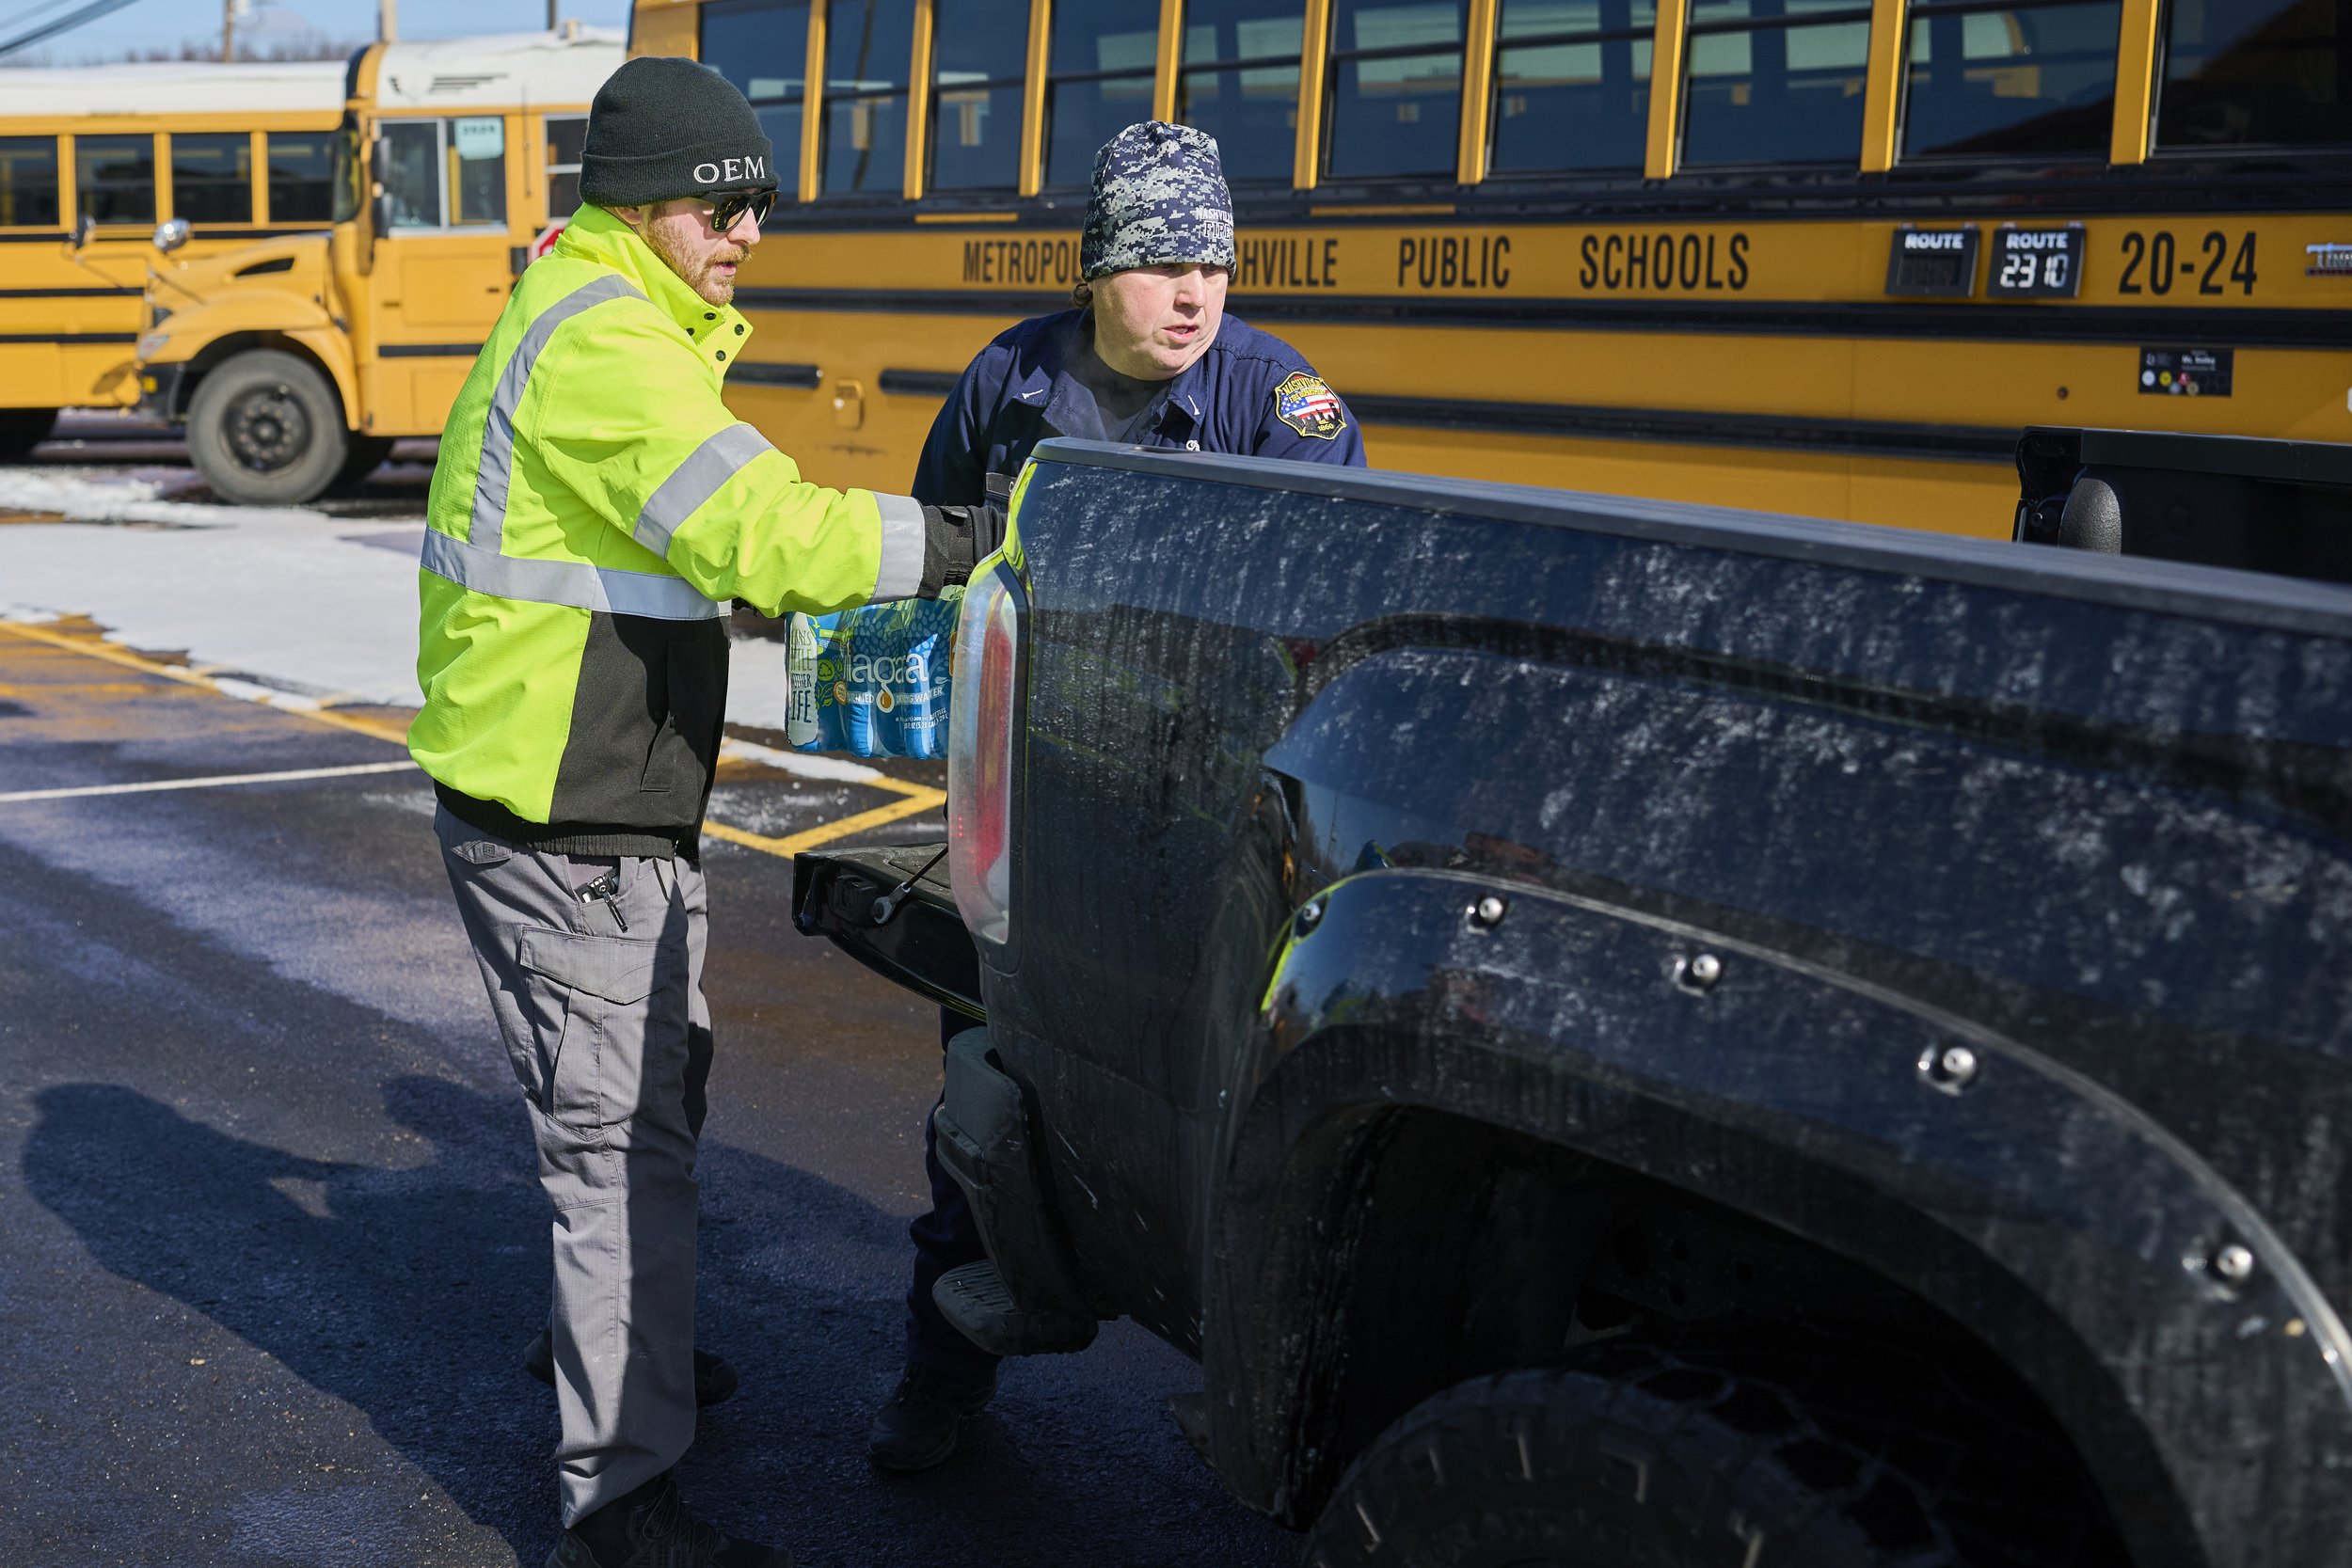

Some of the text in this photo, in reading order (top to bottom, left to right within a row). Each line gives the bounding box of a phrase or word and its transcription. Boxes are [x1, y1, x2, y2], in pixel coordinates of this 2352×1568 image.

[693, 155, 766, 183] OEM
[1904, 232, 1964, 250] ROUTE
[2006, 231, 2068, 250] ROUTE
[962, 240, 1082, 284] METROPOL
[1398, 236, 1510, 289] PUBLIC
[1580, 232, 1750, 291] SCHOOLS
[2118, 230, 2258, 296] 20-24
[1282, 377, 1324, 396] NASHVILLE
[1318, 423, 1334, 432] 1860
[914, 687, 943, 704] WATER
